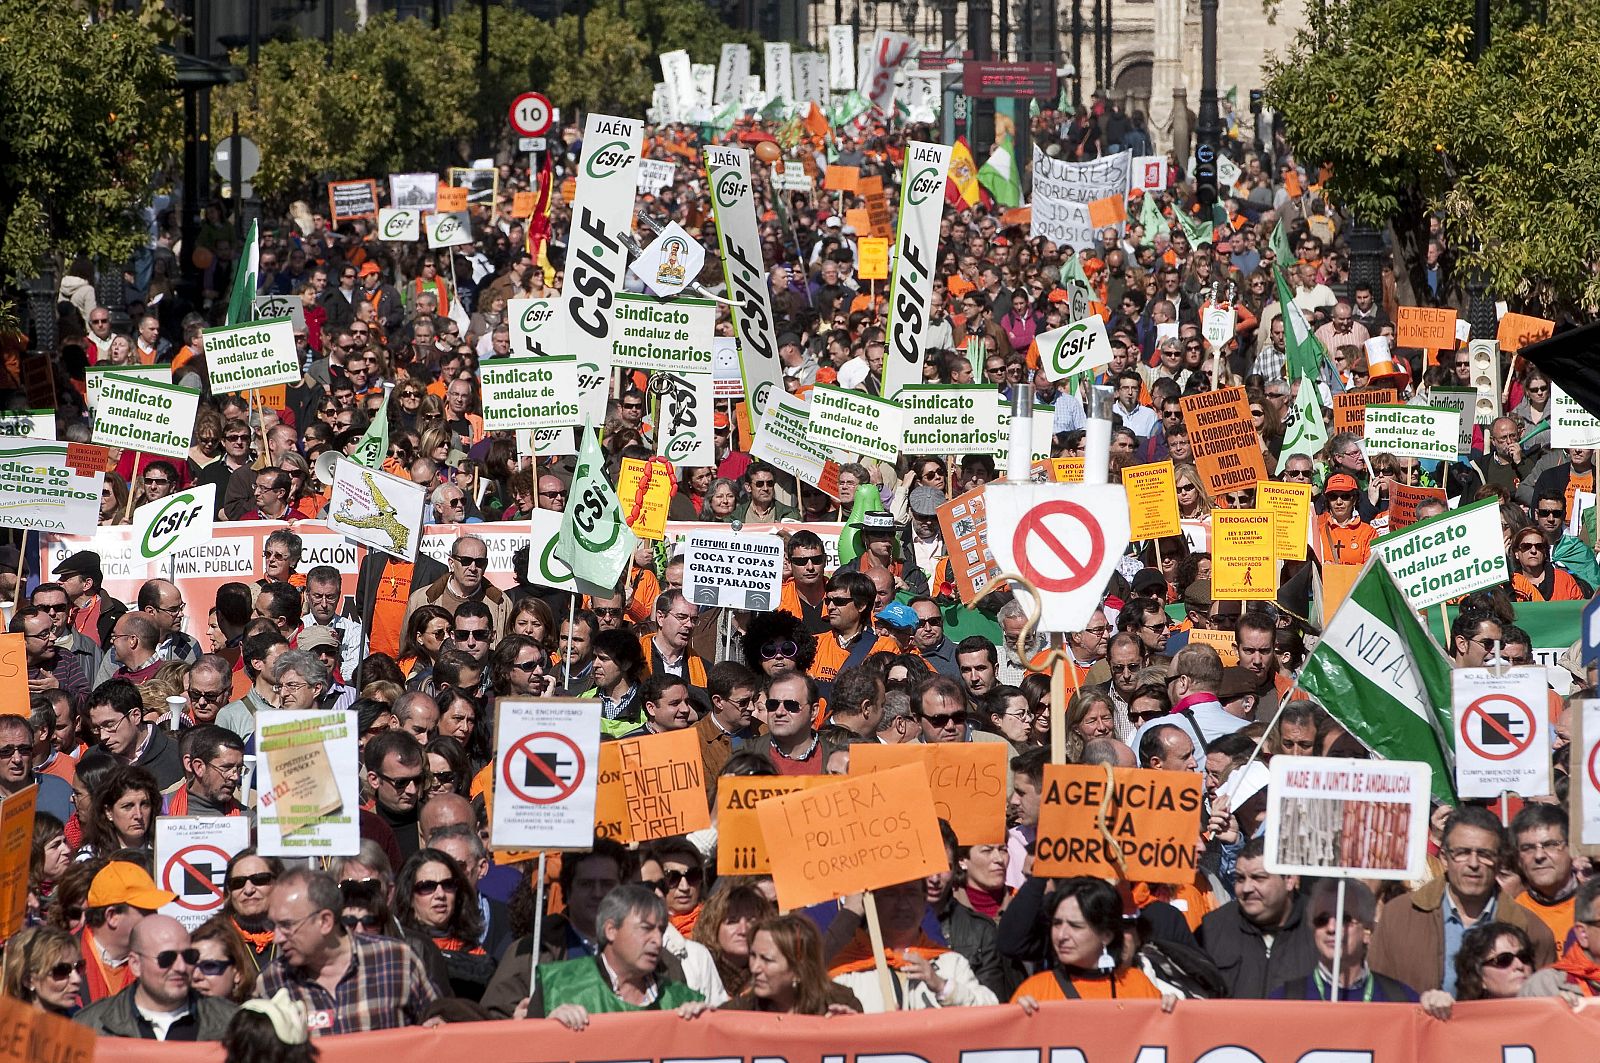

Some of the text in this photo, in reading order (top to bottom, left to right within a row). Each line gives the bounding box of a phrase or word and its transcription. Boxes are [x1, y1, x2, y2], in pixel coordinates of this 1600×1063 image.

[521, 108, 542, 121] 10
[596, 121, 632, 137] JAÉN
[713, 153, 741, 167] JAÉN
[914, 148, 942, 163] JAÉN
[615, 304, 689, 324] sindicato
[205, 331, 271, 352] sindicato
[624, 327, 689, 340] andaluz de
[217, 348, 274, 365] andaluz de
[612, 340, 712, 362] funcionarios
[210, 360, 298, 384] funcionarios
[482, 368, 553, 384] sindicato
[101, 384, 172, 409] sindicato
[493, 387, 555, 400] andaluz de
[904, 394, 974, 409] sindicato
[1185, 389, 1241, 412] LA ILEGALIDAD
[484, 401, 579, 420] funcionarios
[813, 393, 880, 418] sindicato
[108, 406, 170, 425] andaluz de
[821, 410, 879, 432] andaluz de
[914, 414, 975, 425] andaluz de
[1196, 407, 1239, 426] ENGENDRA
[1346, 410, 1364, 422] ENGE
[1366, 412, 1435, 425] sindicato
[95, 418, 190, 448] funcionarios
[809, 421, 898, 454] funcionarios
[903, 429, 997, 444] funcionarios
[1191, 419, 1255, 444] LA CORRUPCIÓN
[1375, 426, 1435, 436] andaluz de
[1193, 432, 1257, 458] LA CORRUPCIÓN
[1366, 438, 1457, 453] funcionarios
[1218, 454, 1241, 469] MATA
[0, 462, 69, 478] dicato
[628, 466, 668, 477] DEROCIÓN
[773, 457, 818, 484] GRANAD
[1210, 474, 1222, 488] LO
[1223, 467, 1257, 486] PÚBLICO
[0, 473, 68, 486] daluz de
[0, 482, 97, 501] cionarios
[1264, 487, 1305, 496] DEROGACIÓN
[1219, 515, 1269, 524] DEROGACIÓN
[691, 539, 728, 549] FIESTUKI
[754, 545, 780, 554] JUNTA
[1384, 524, 1467, 564] indicato
[300, 543, 356, 564] CACIÓN
[694, 552, 725, 563] COCA
[737, 557, 775, 568] COPAS
[1452, 545, 1471, 560] de
[160, 558, 253, 574] AMIN. PÚBLICA
[492, 556, 515, 568] VIVI
[690, 563, 777, 579] GRATIS. PAGAN
[694, 575, 771, 590] LOS PARADOS
[1345, 623, 1390, 666] NO
[1286, 771, 1411, 793] MADE IN JUNTA DE ANDALUCÍA
[1045, 780, 1199, 811] AGENCIAS
[805, 811, 911, 850] POLITICOS
